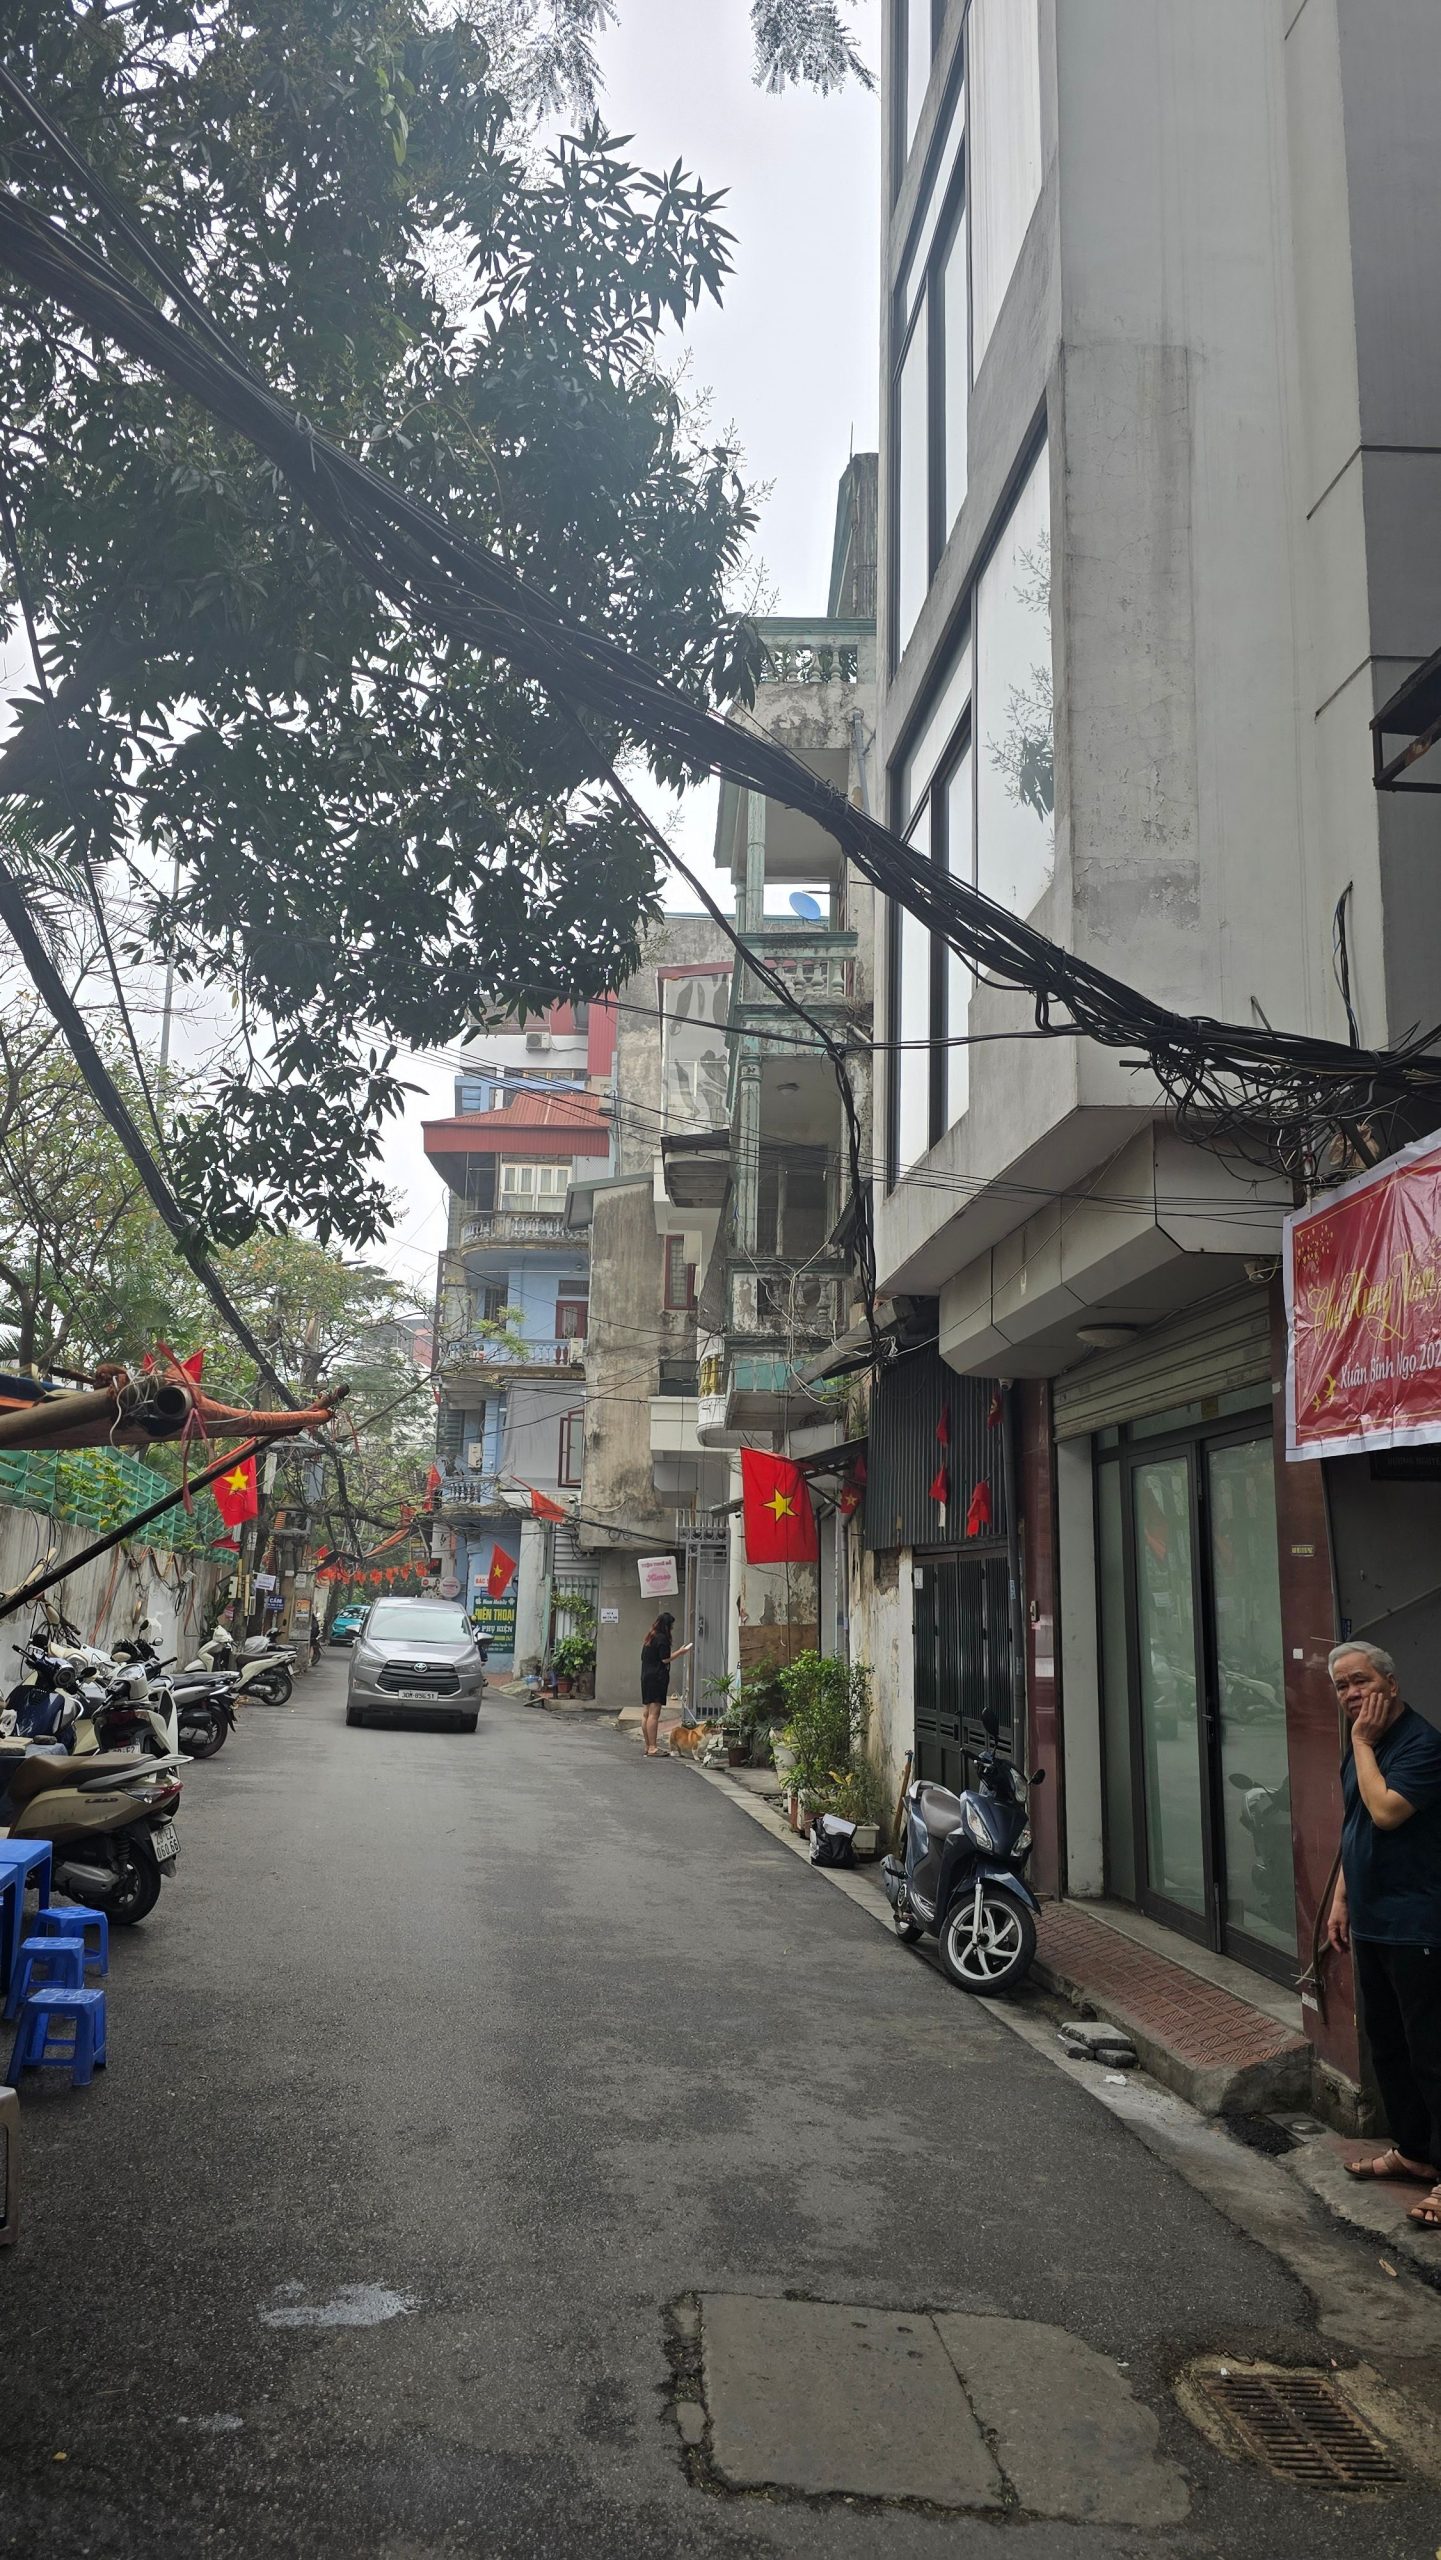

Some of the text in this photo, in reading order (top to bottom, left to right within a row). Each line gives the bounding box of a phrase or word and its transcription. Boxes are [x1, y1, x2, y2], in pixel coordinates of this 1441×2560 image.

[1340, 1361, 1368, 1389] Xuân
[1371, 1356, 1395, 1383] Bính
[1396, 1351, 1417, 1380] Ngọ
[493, 1608, 515, 1624] THOẠI
